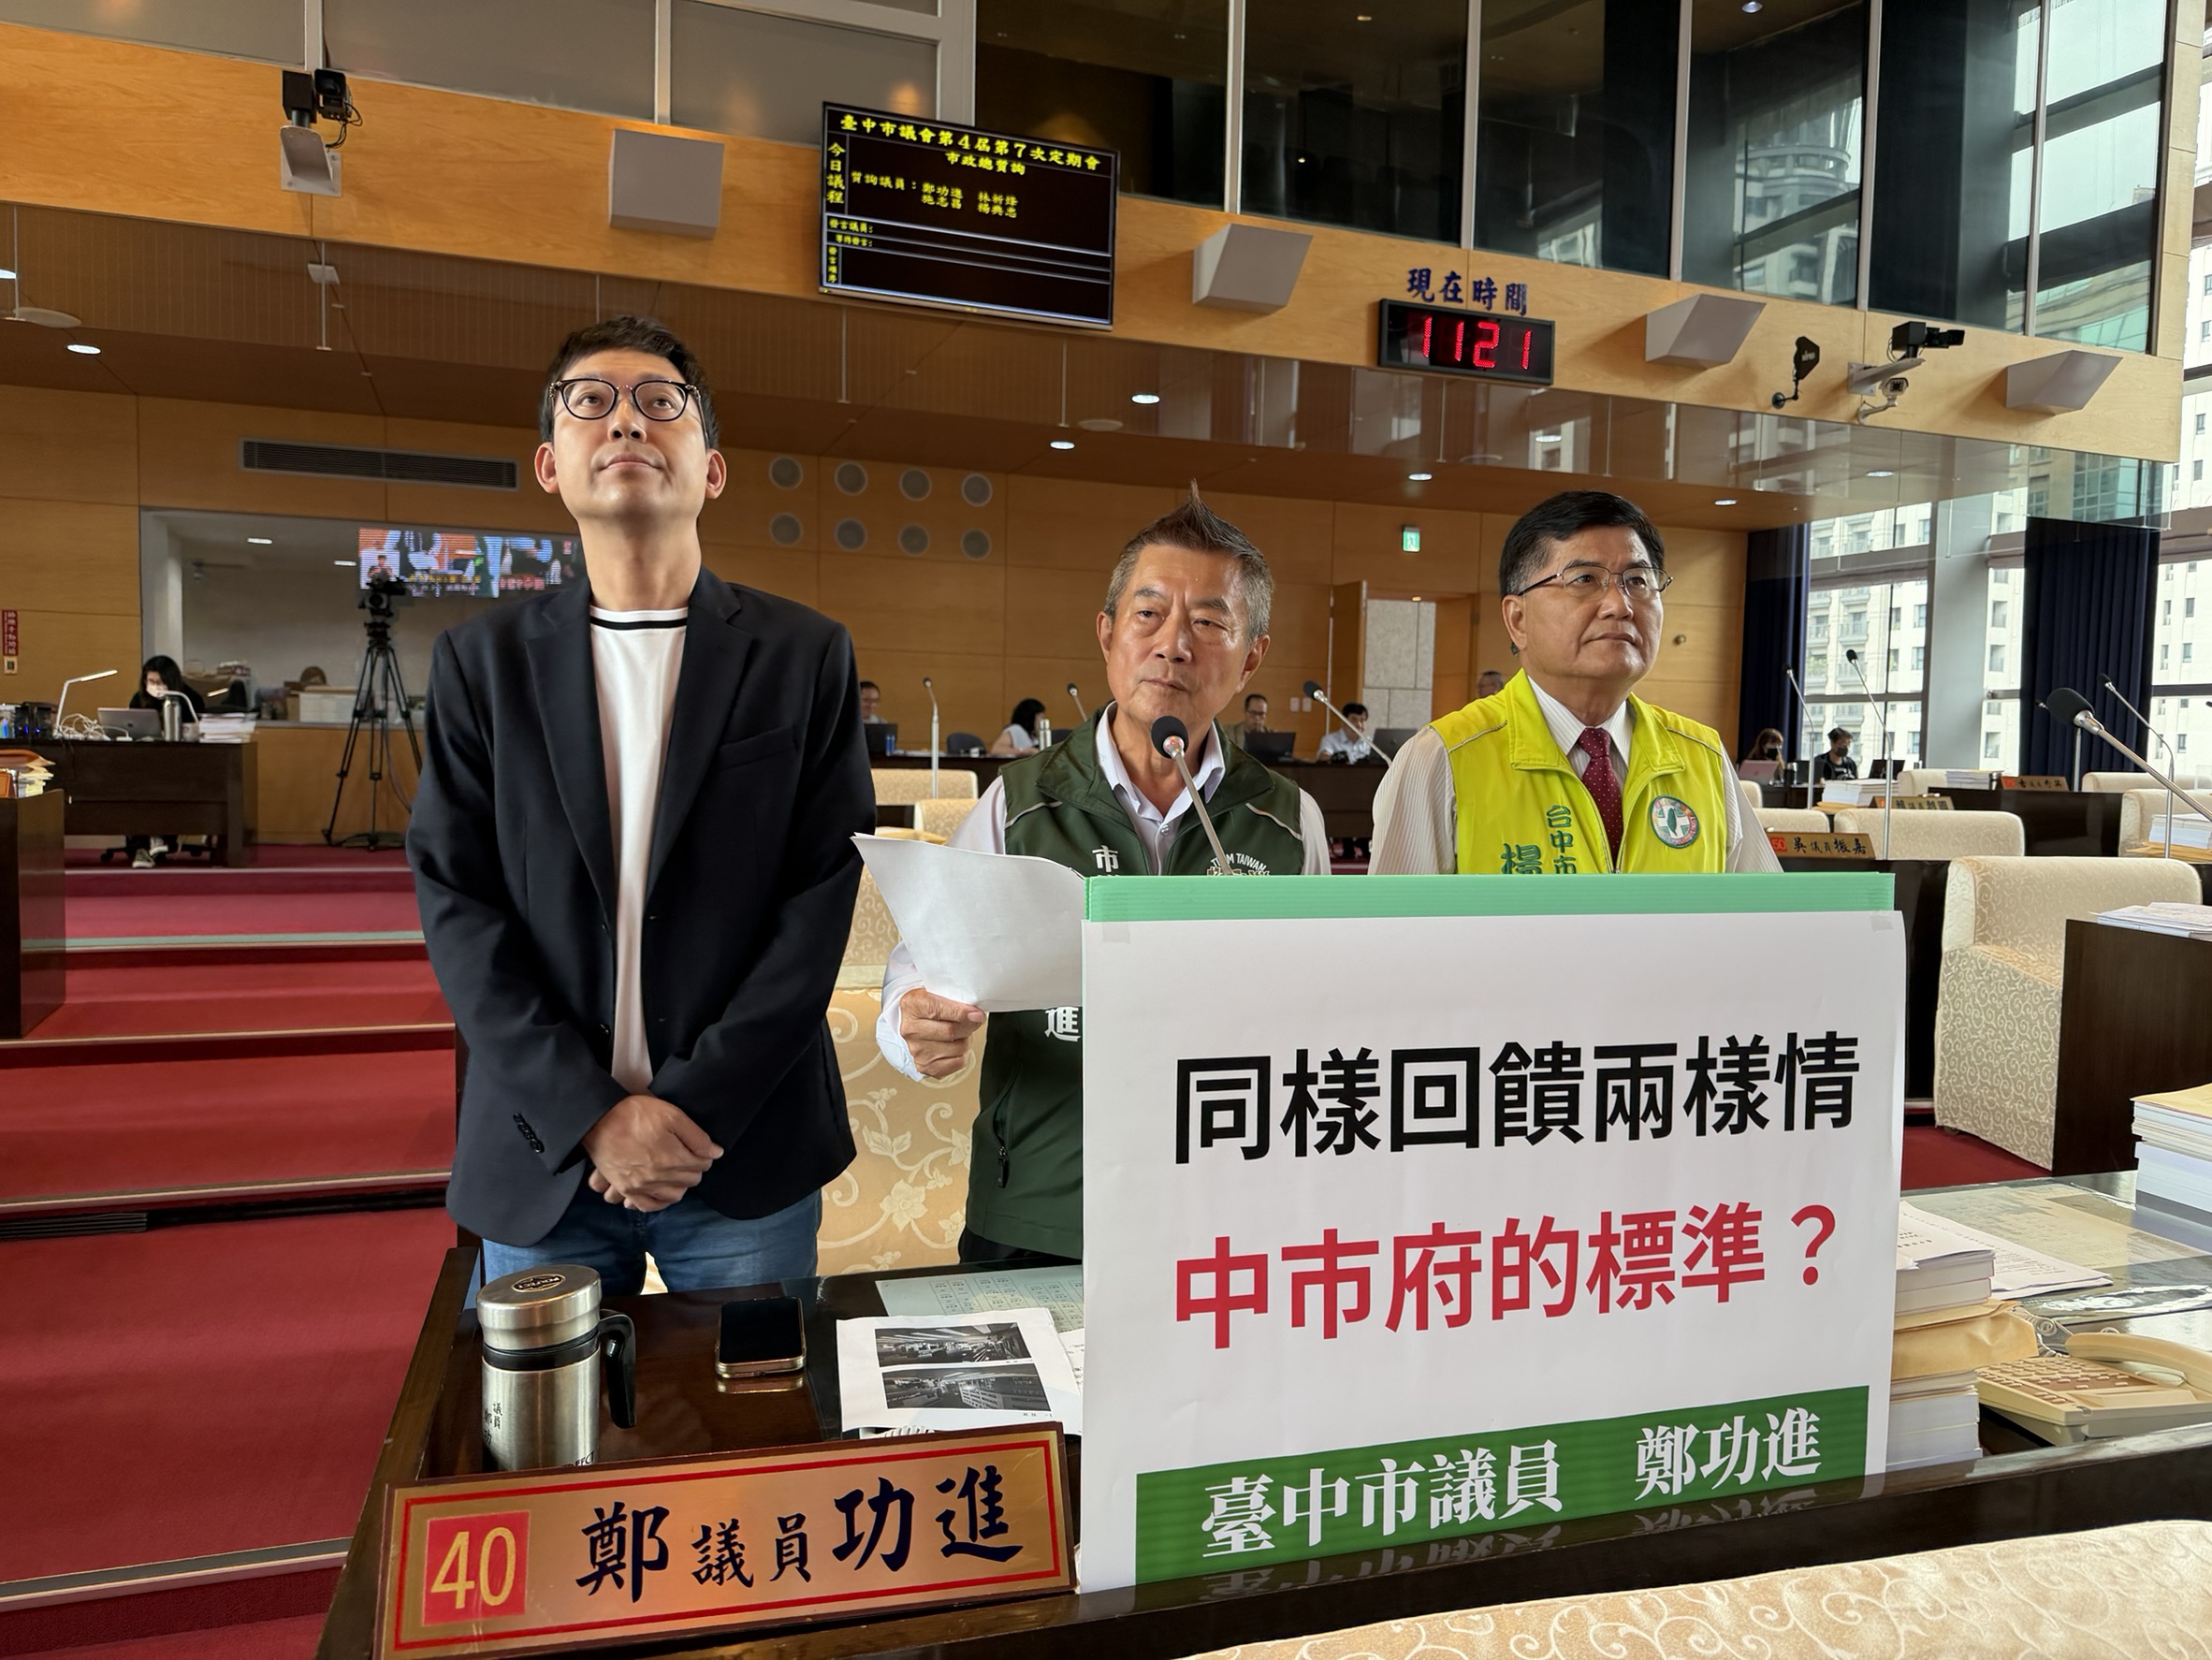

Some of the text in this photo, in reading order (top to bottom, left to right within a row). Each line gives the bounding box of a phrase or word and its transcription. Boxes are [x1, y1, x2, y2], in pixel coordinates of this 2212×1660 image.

[826, 142, 846, 205] 今日議程
[840, 113, 1101, 171] 臺中市議會第4屆第7次定期會
[1406, 268, 1528, 316] 現在時間
[1235, 852, 1267, 871] TAIWAN
[1501, 843, 1543, 874] 楊
[1546, 805, 1578, 874] 台中市
[1771, 838, 1787, 852] 50
[1175, 1030, 1860, 1165] 同樣回饋兩樣情
[1176, 1202, 1837, 1349] 中市府的標準？
[1201, 1406, 1823, 1558] 臺中市議員 鄭功進
[430, 1464, 1025, 1609] 40 鄭議員功進
